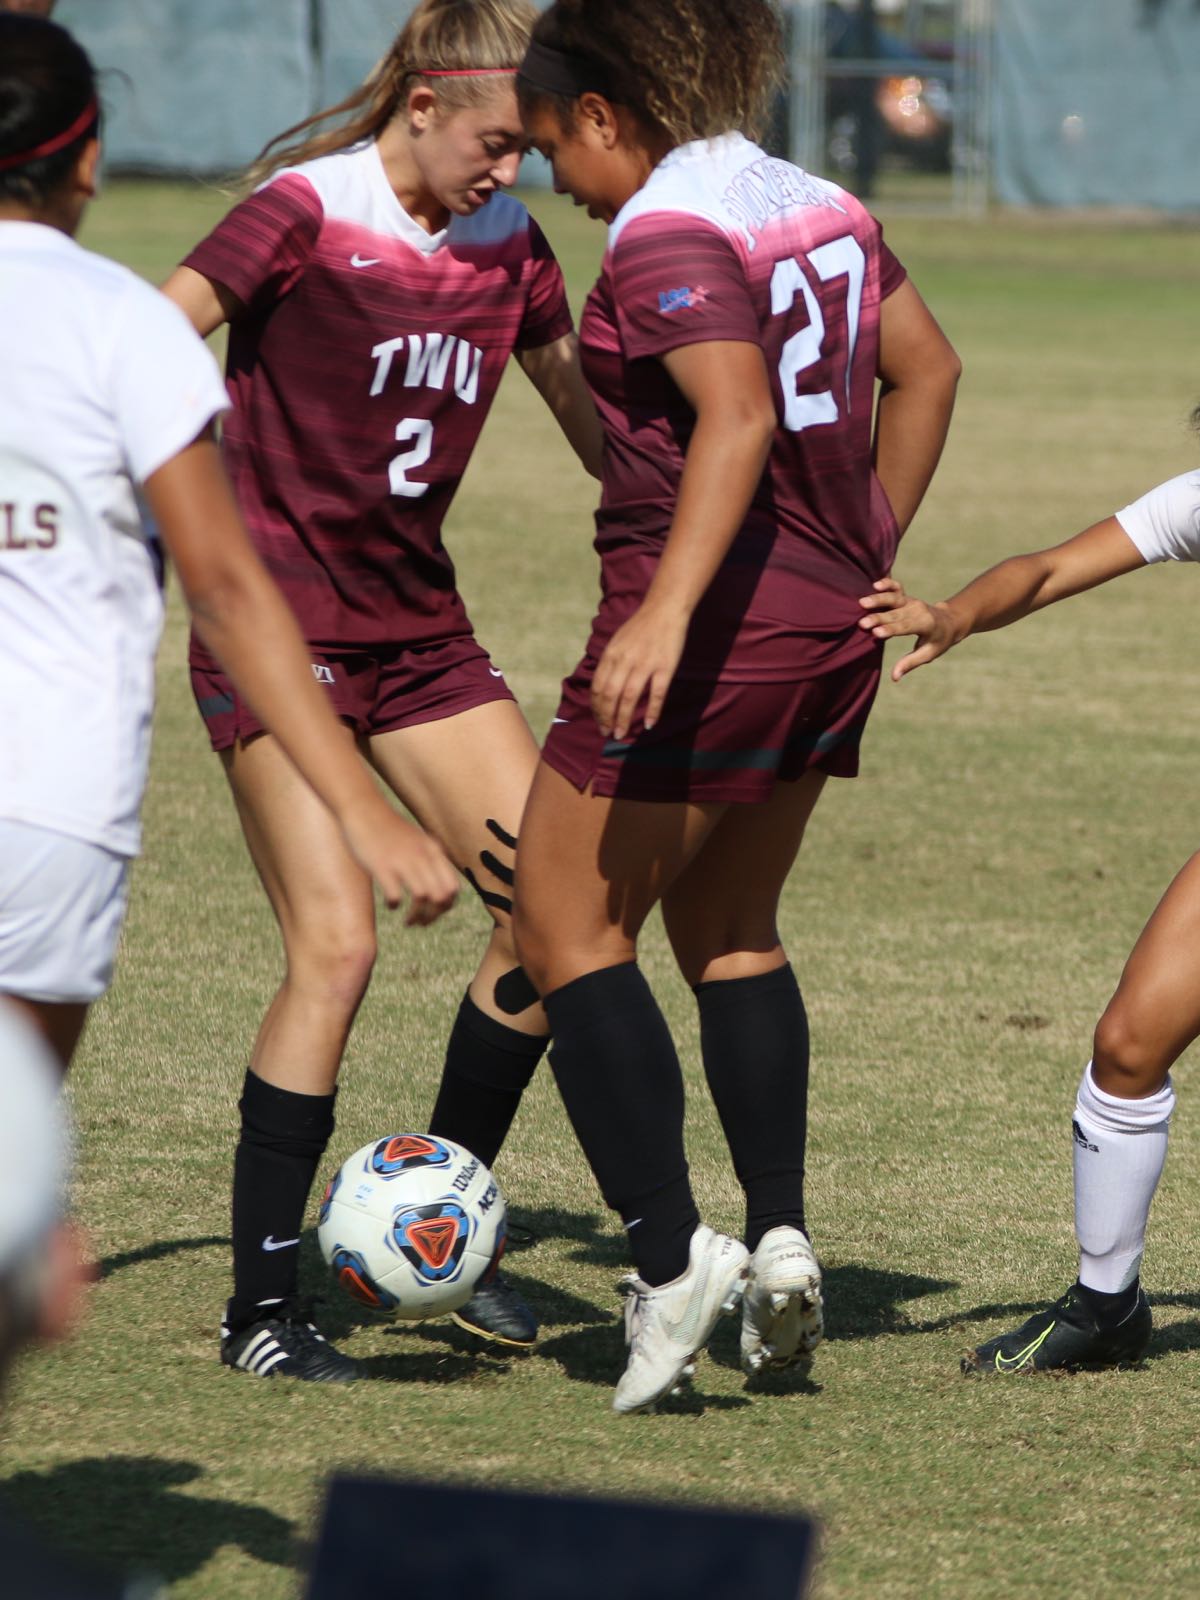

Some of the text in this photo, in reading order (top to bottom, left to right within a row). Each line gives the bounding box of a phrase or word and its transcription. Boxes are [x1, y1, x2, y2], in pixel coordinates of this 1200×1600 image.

[369, 332, 483, 405] TWU
[770, 234, 866, 432] 27
[389, 418, 434, 497] 2
[0, 502, 58, 550] LS
